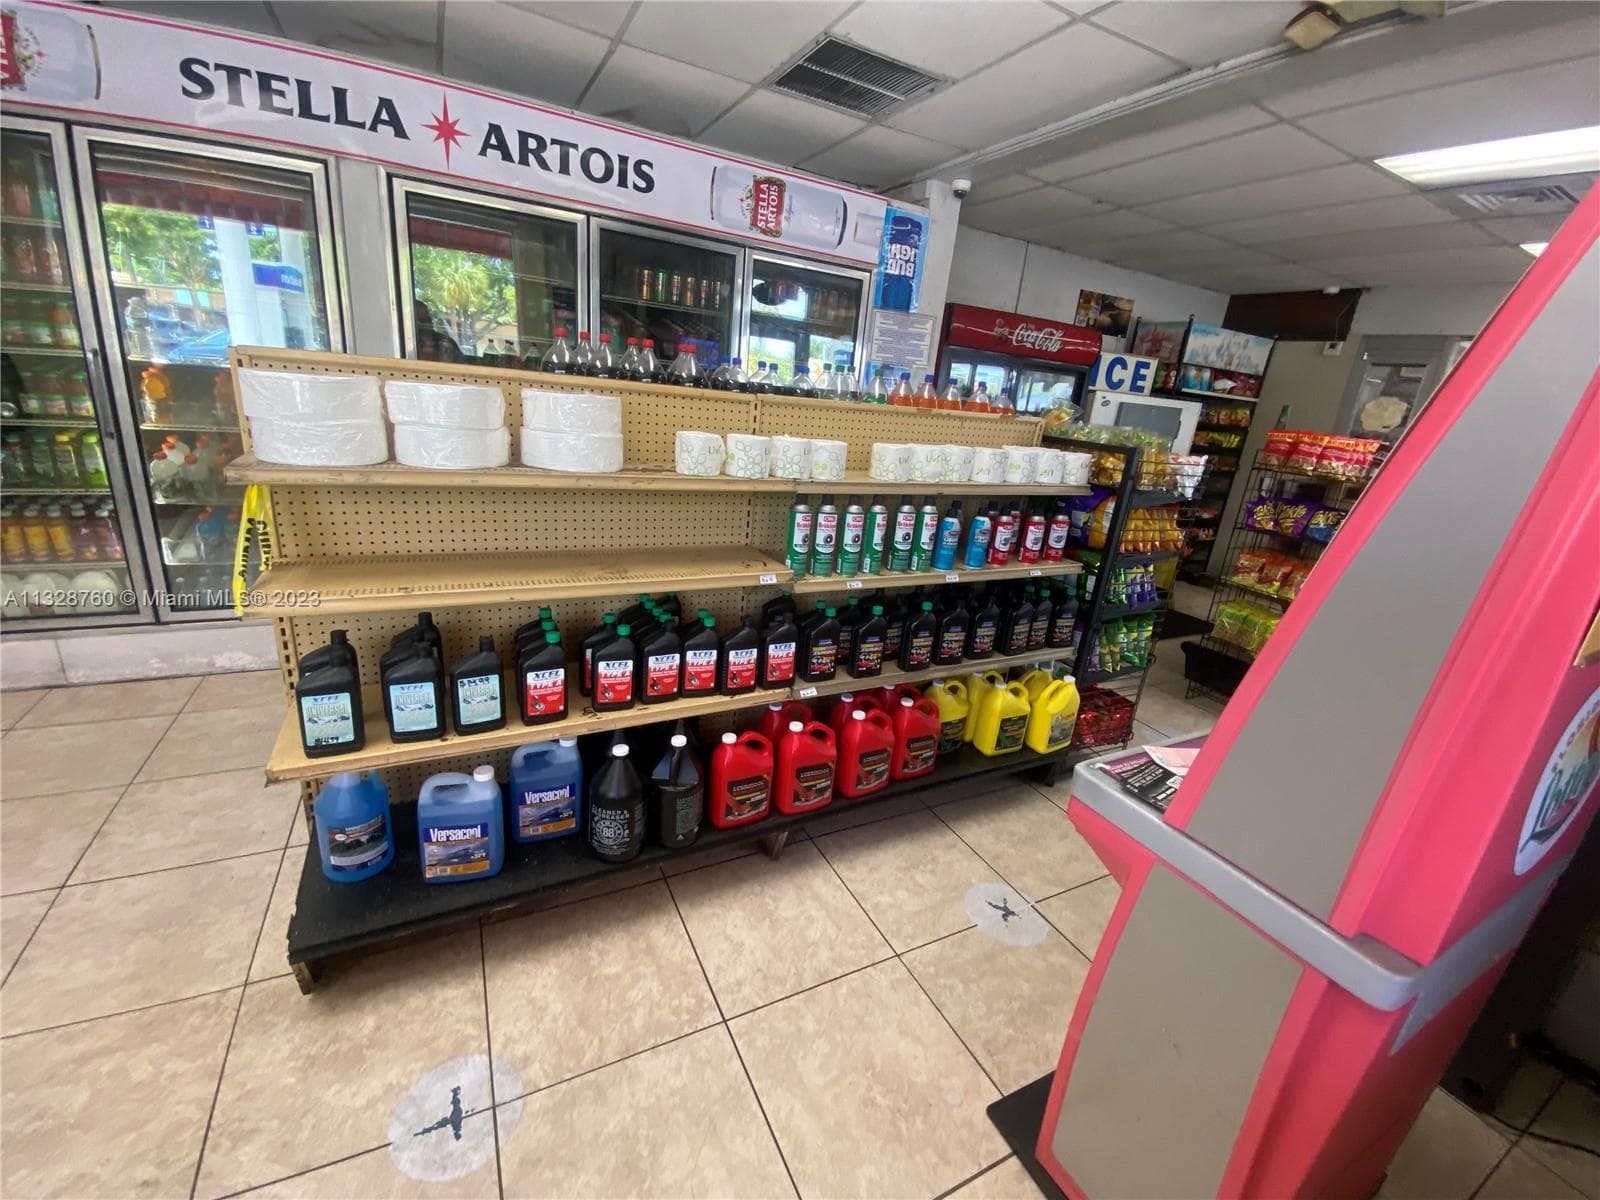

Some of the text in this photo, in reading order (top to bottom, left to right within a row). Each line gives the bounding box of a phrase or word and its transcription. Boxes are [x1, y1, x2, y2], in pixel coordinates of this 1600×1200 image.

[180, 57, 655, 194] STELLA ARTOIS
[757, 183, 769, 229] STELLA
[766, 185, 779, 230] ARTOIS
[885, 258, 915, 278] BUD
[1088, 354, 1151, 393] ICE
[524, 785, 570, 805] Versacool
[430, 825, 481, 842] Versacool
[602, 827, 615, 838] 88
